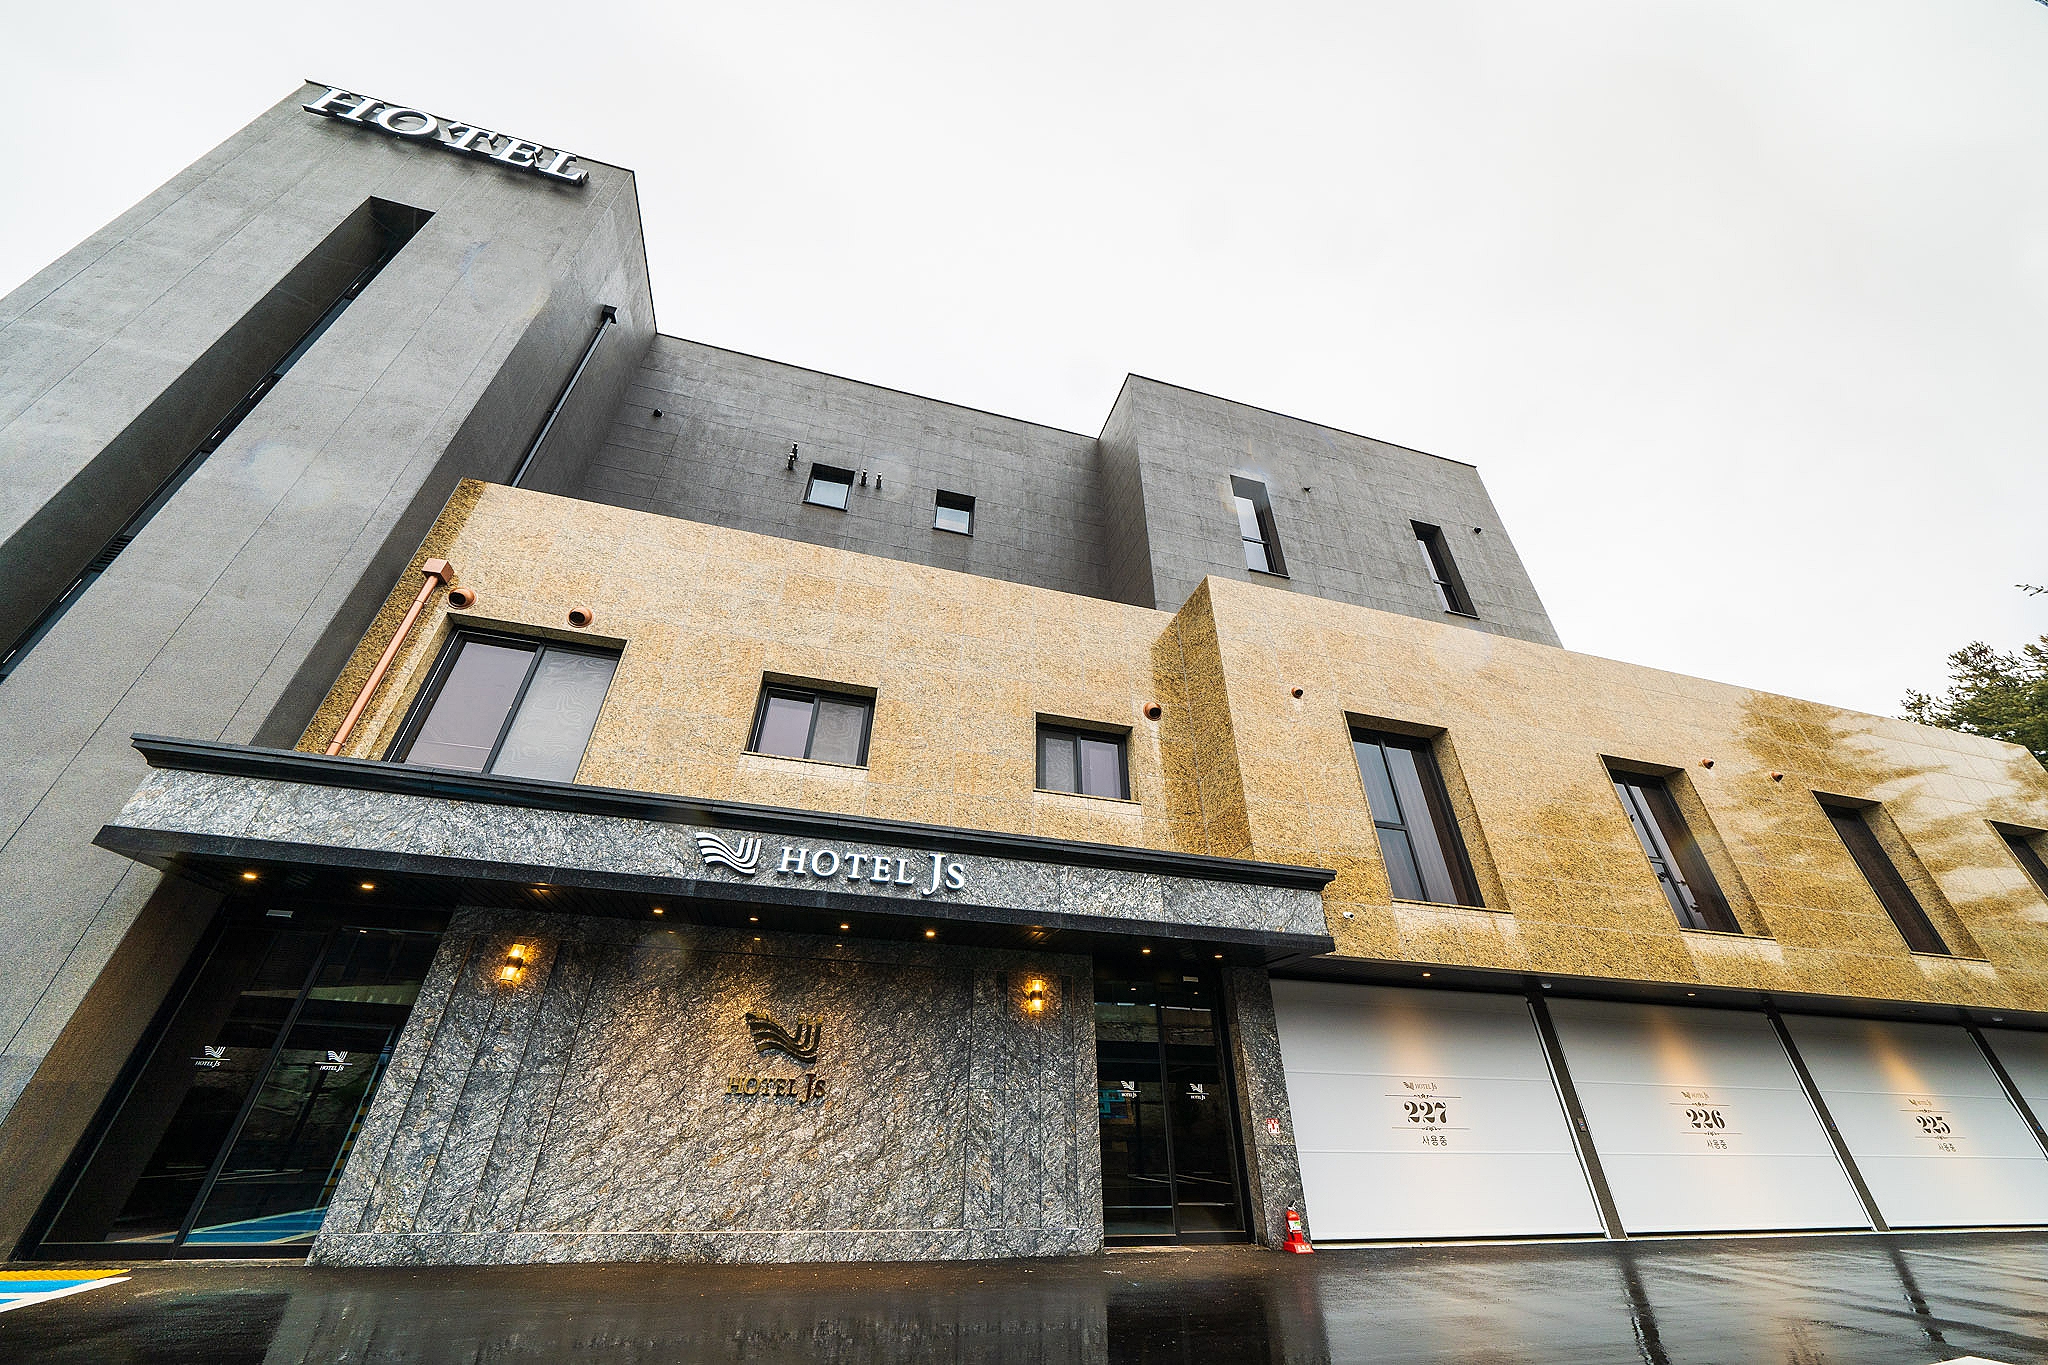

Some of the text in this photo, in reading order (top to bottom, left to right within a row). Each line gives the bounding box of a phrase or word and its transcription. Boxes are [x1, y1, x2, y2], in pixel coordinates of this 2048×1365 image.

[301, 86, 590, 185] HOTEL
[776, 846, 915, 886] HOTEL
[725, 1077, 799, 1098] HOTEL
[1404, 1101, 1447, 1123] 227
[1686, 1108, 1726, 1129] 226
[1916, 1115, 1951, 1134] 225
[1422, 1135, 1448, 1147] 사용중
